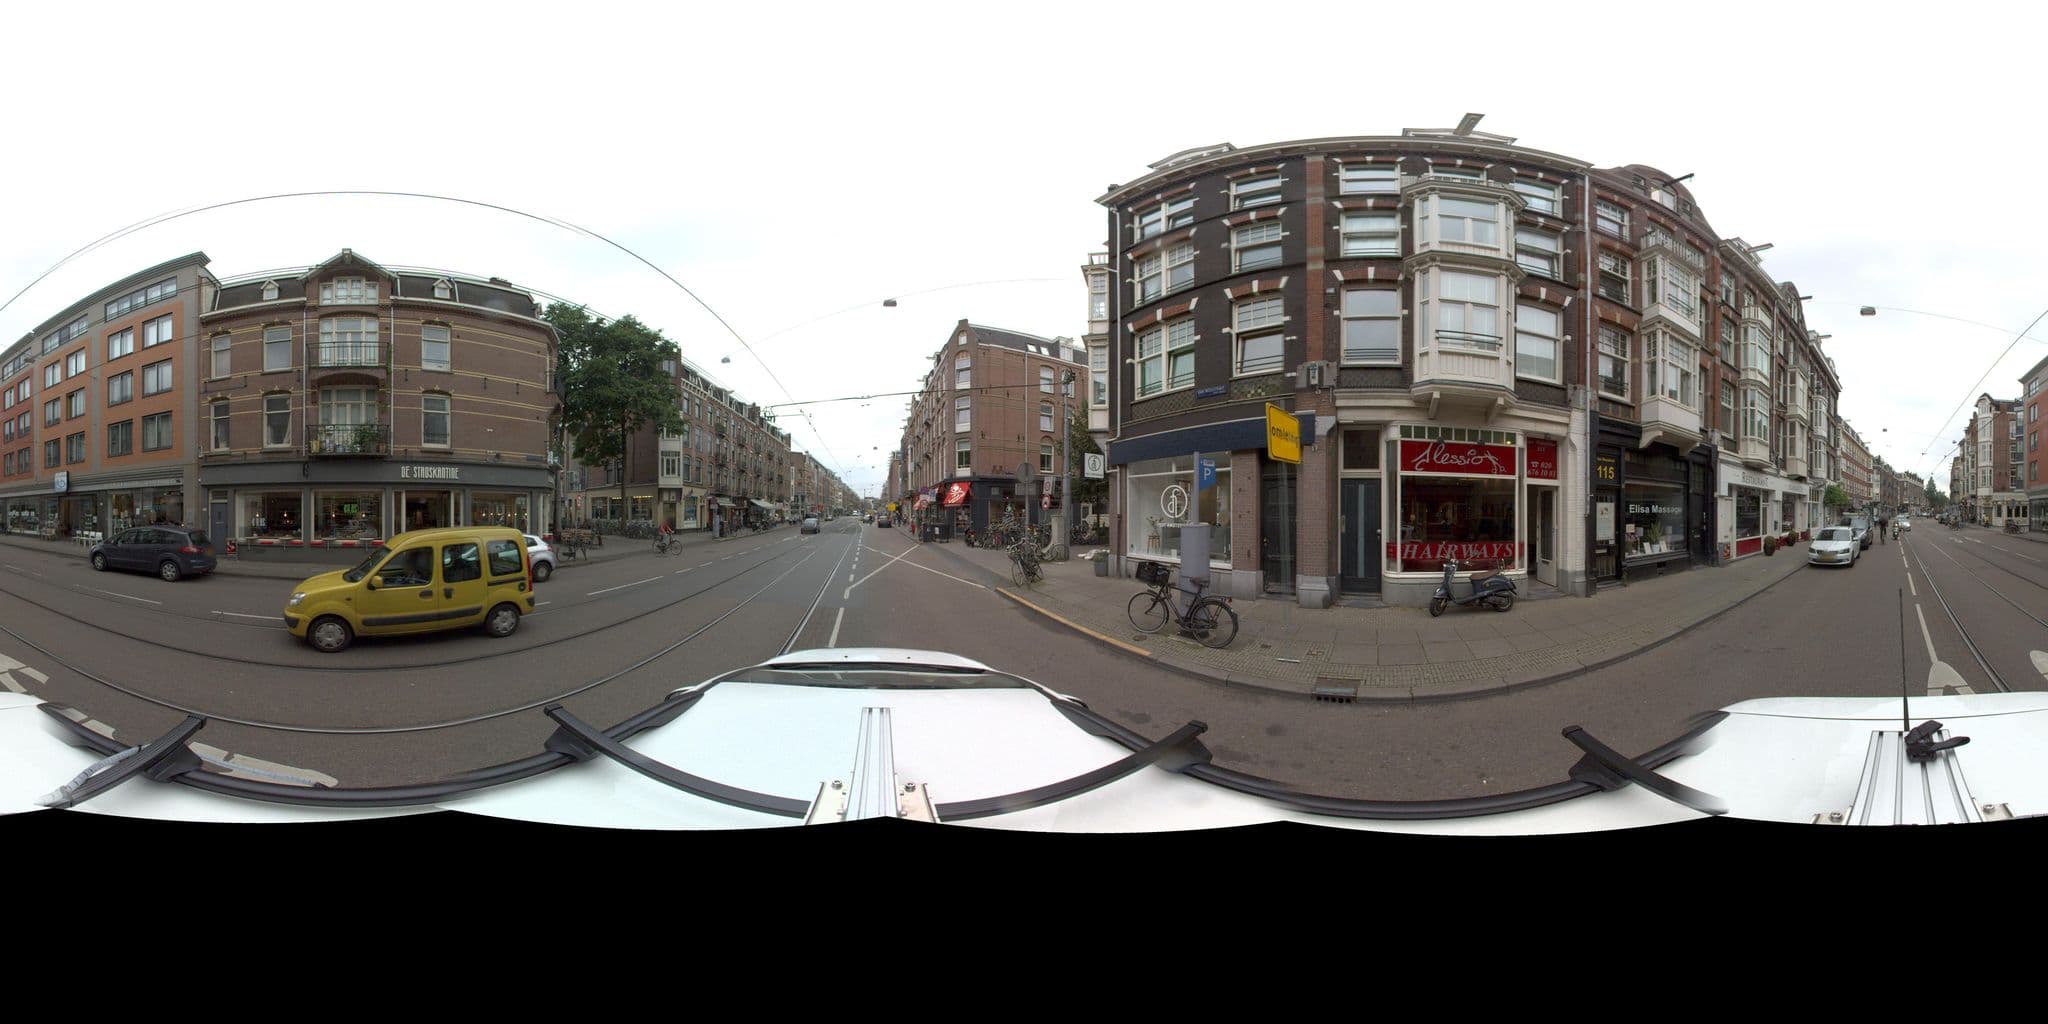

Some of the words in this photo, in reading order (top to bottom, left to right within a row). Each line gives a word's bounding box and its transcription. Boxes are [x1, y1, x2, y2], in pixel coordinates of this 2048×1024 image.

[401, 466, 410, 478] DE
[1204, 468, 1211, 480] P
[1597, 464, 1614, 480] 115
[1629, 504, 1650, 513] Elisa
[1651, 504, 1683, 515] Massage
[1402, 543, 1514, 560] HAIRWAYS
